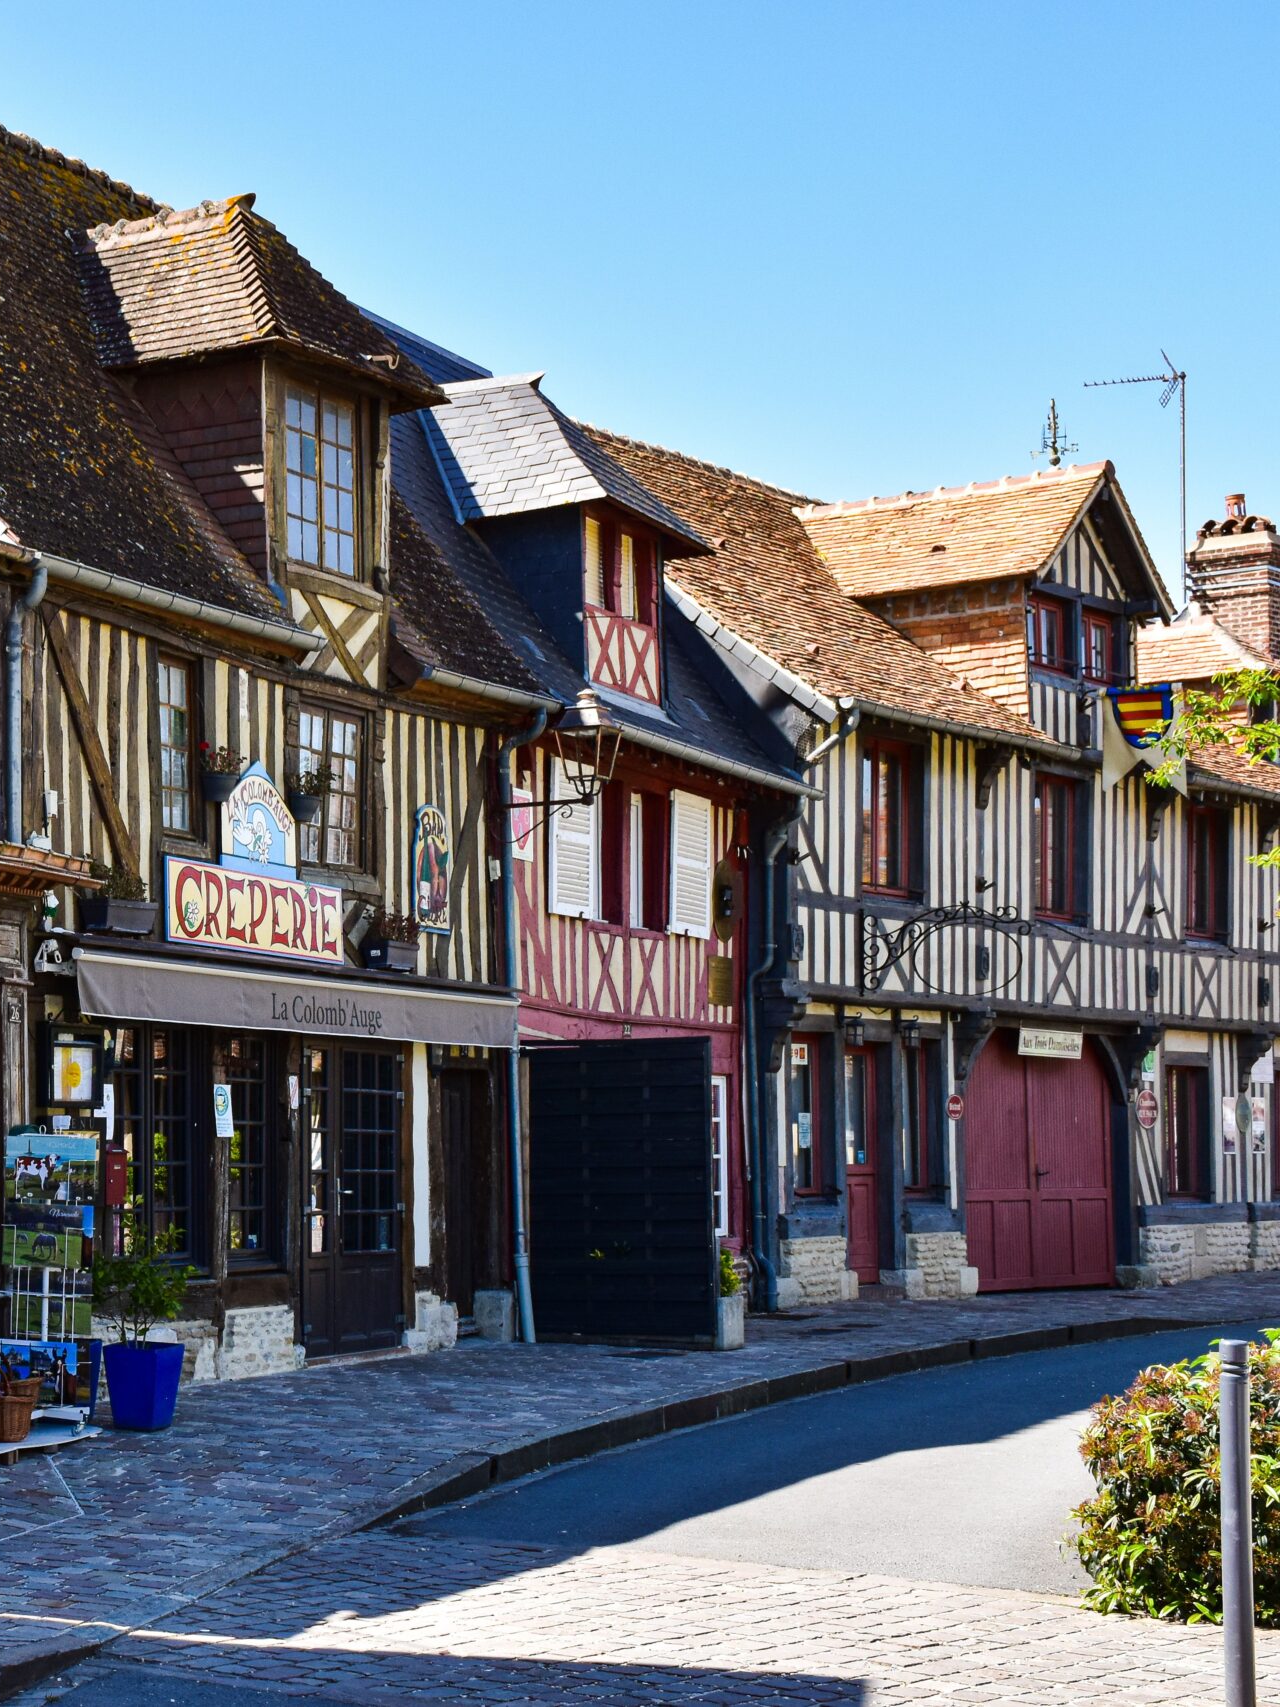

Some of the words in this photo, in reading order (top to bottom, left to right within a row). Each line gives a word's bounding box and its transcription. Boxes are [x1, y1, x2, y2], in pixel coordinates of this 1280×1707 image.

[419, 811, 446, 845] BAR
[11, 1006, 20, 1020] 26
[272, 993, 288, 1020] La
[293, 995, 383, 1035] Colomb'Auge
[624, 1024, 631, 1035] 22
[1023, 1035, 1033, 1048] Aux
[1034, 1035, 1048, 1049] Trois
